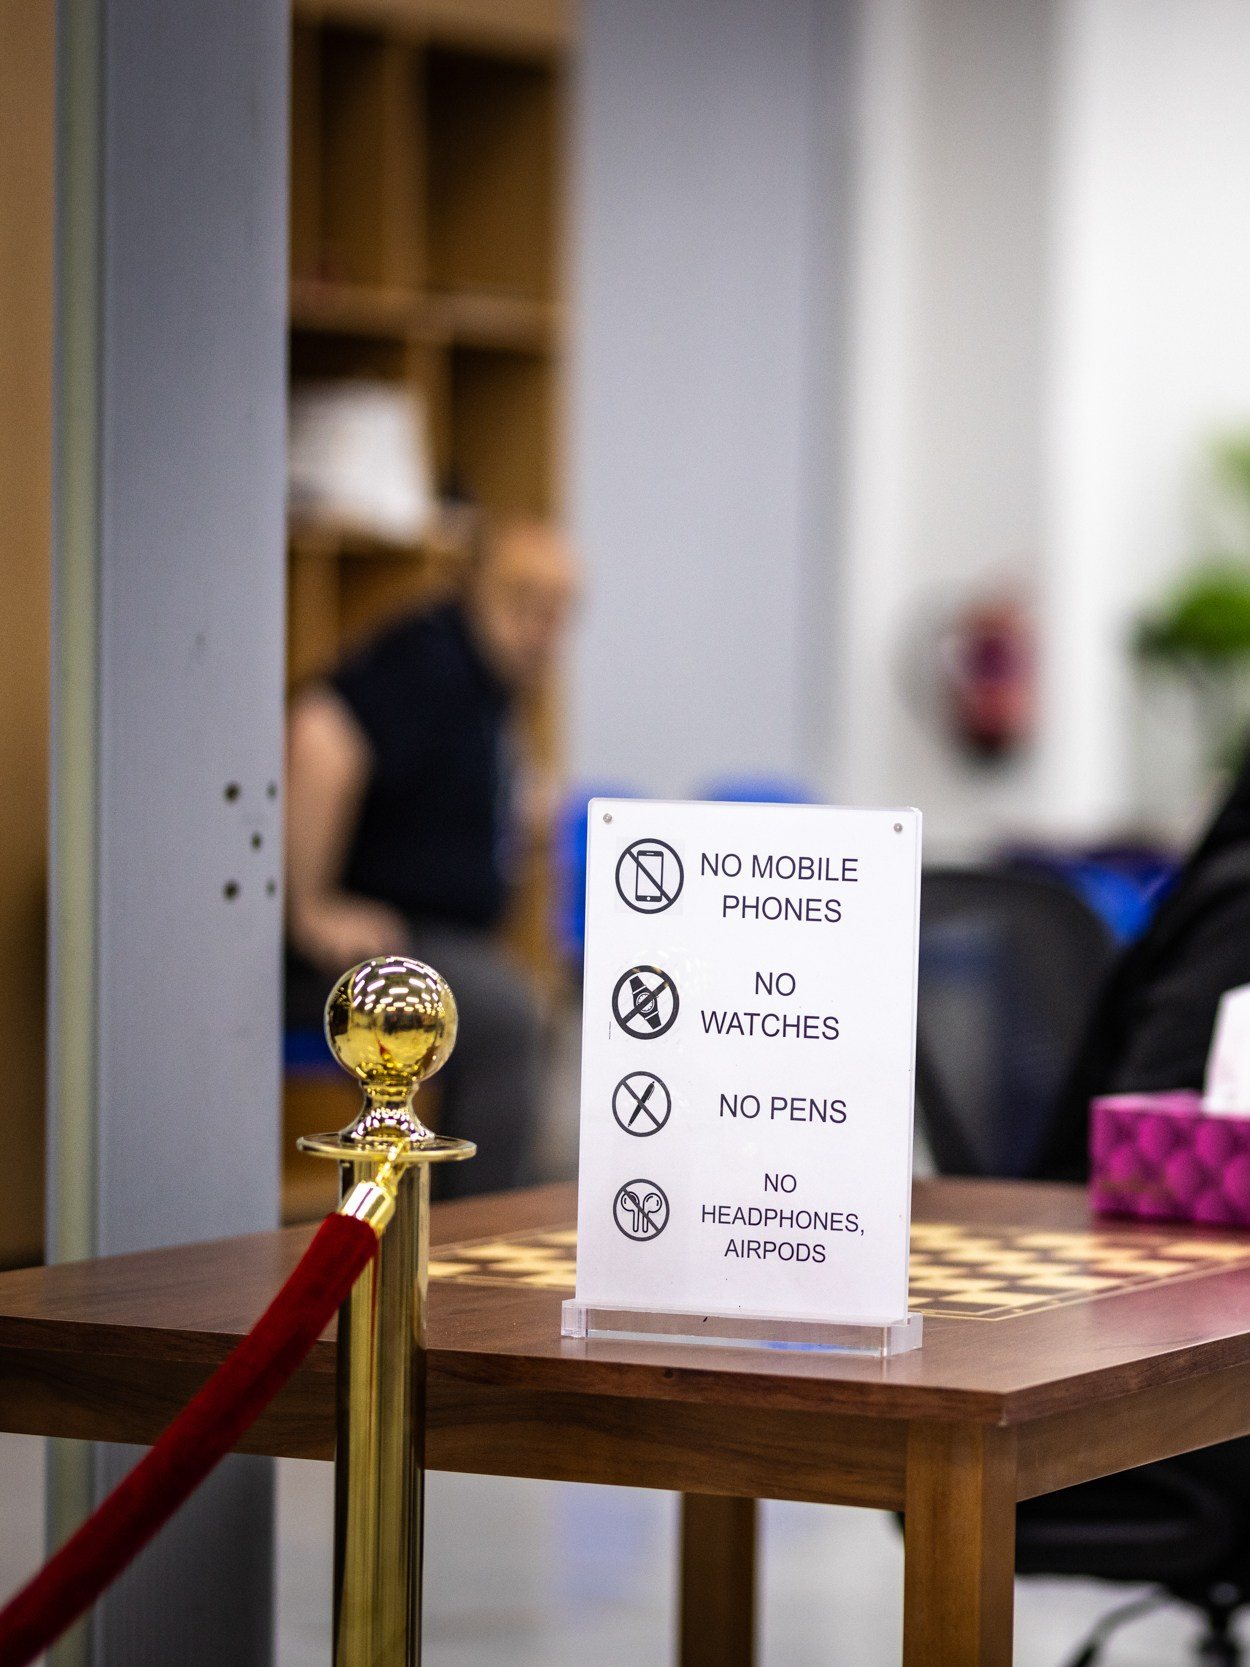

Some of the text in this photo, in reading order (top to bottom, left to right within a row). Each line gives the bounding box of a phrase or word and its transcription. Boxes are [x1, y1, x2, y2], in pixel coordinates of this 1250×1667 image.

[701, 852, 859, 882] NO MOBILE
[722, 894, 842, 923] PHONES
[755, 971, 796, 997] NO
[700, 1010, 840, 1041] WATCHES
[719, 1093, 847, 1124] NO PENS
[764, 1173, 797, 1194] NO
[701, 1204, 864, 1236] HEADPHONES,
[723, 1238, 826, 1264] AIRPODS
